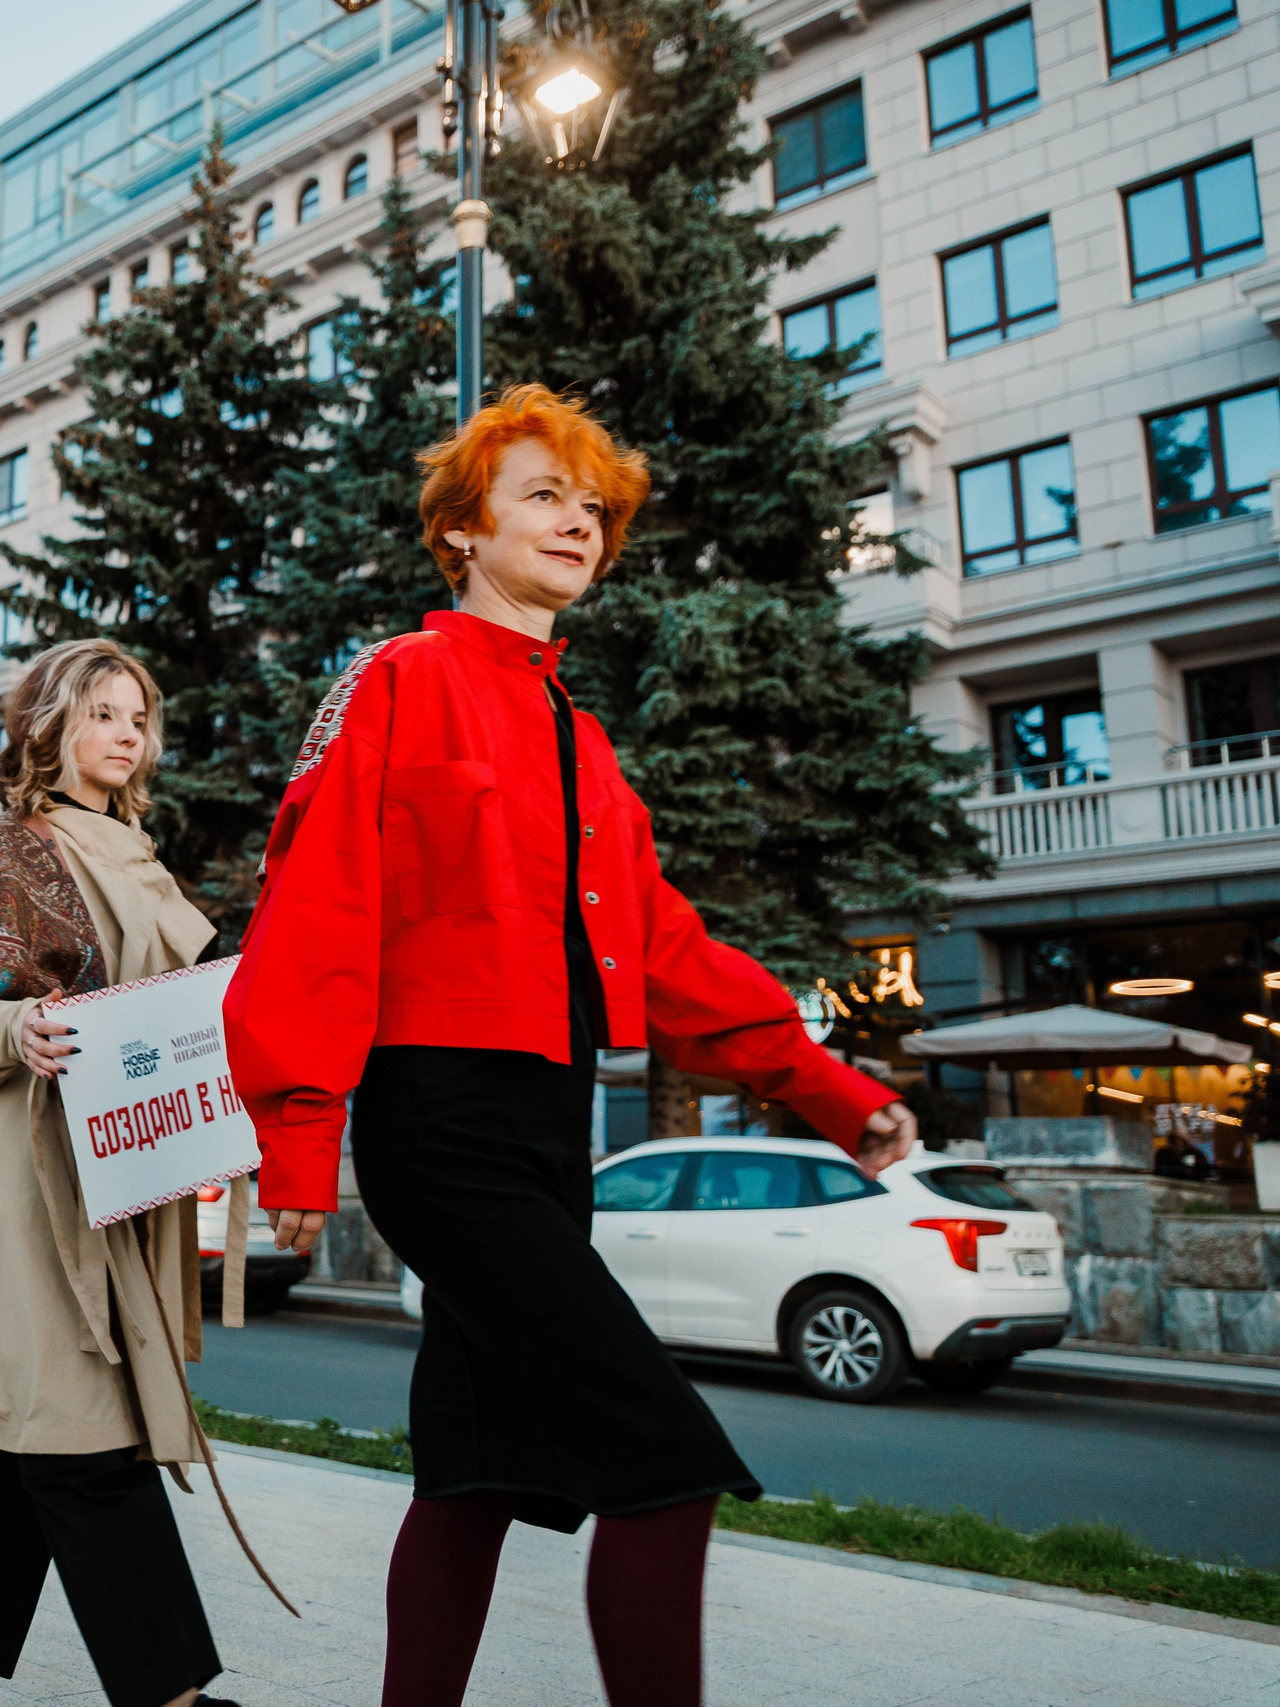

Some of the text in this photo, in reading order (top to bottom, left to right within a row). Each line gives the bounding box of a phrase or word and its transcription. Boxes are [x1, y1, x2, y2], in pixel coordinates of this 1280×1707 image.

[170, 1024, 218, 1049] МОДНЫЙ
[122, 1048, 161, 1069] НОВЫЕ
[173, 1039, 221, 1064] НИЖНИЙ
[126, 1062, 158, 1080] ЛЮДИ
[87, 1088, 193, 1159] СОЗДАНО
[196, 1081, 215, 1124] В
